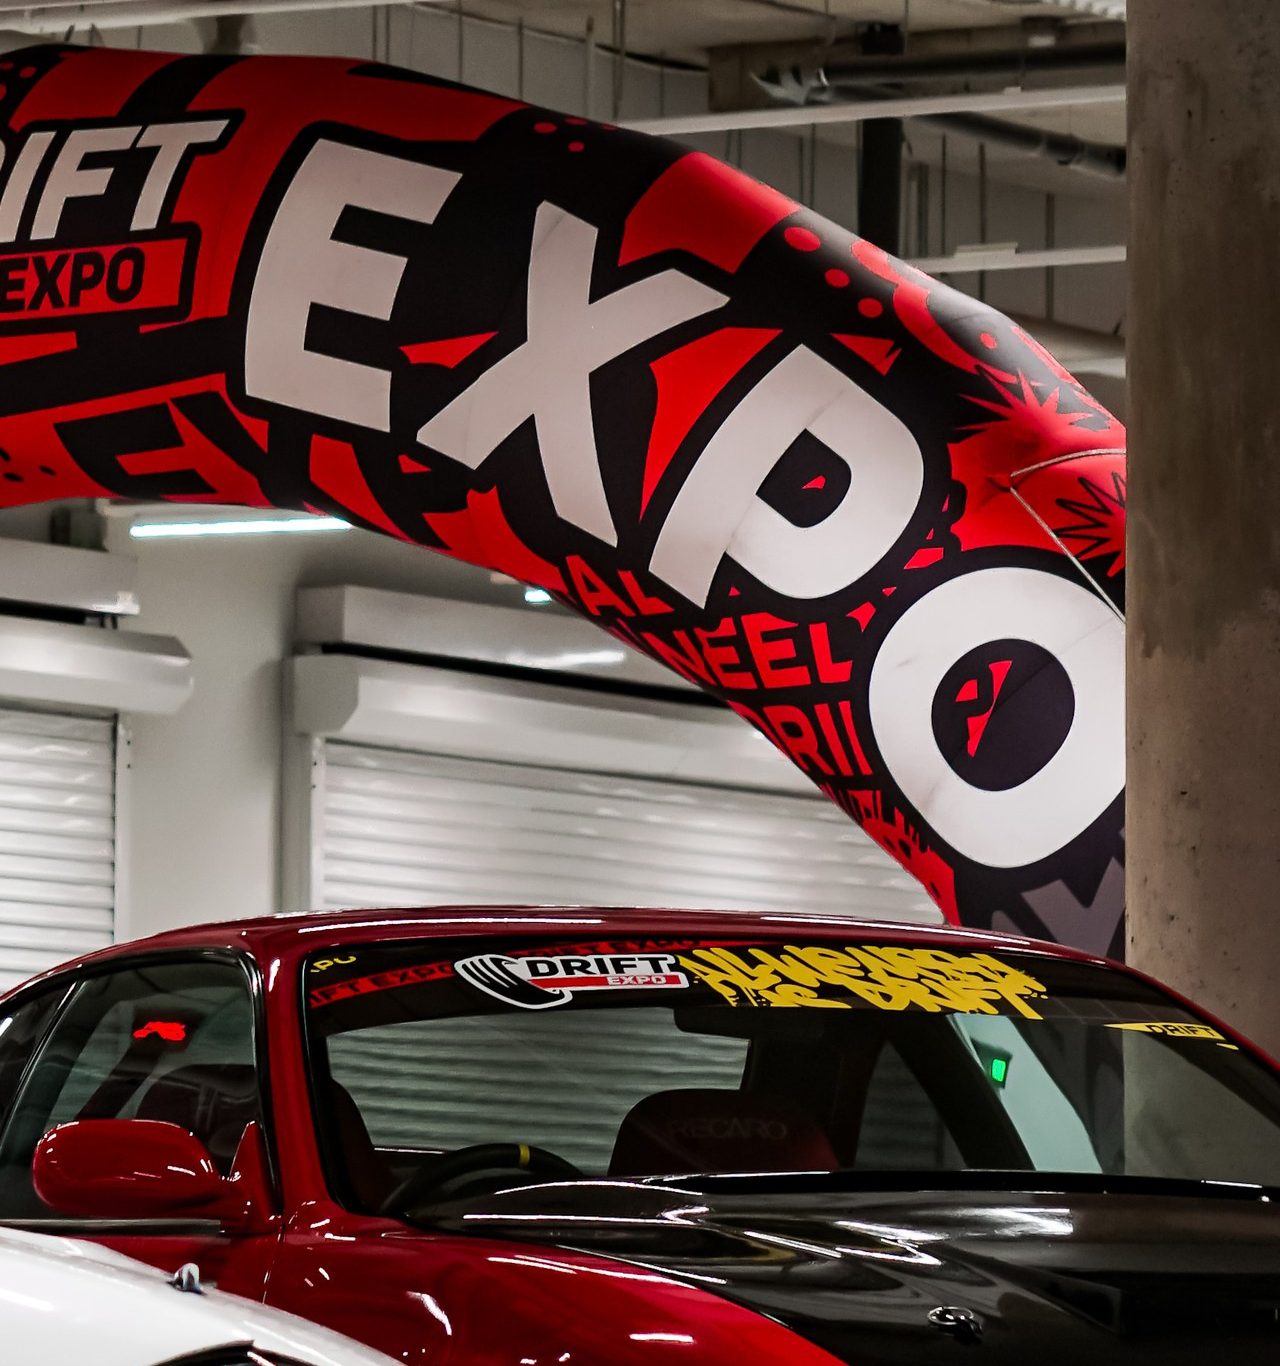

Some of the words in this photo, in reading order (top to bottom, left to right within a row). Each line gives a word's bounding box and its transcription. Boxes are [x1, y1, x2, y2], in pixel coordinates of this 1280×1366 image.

[245, 137, 1126, 868] EXPO
[525, 956, 668, 978] DRIFT
[607, 975, 667, 986] EXPO
[1145, 1023, 1217, 1037] DRIFT
[670, 1117, 787, 1140] RECARO
